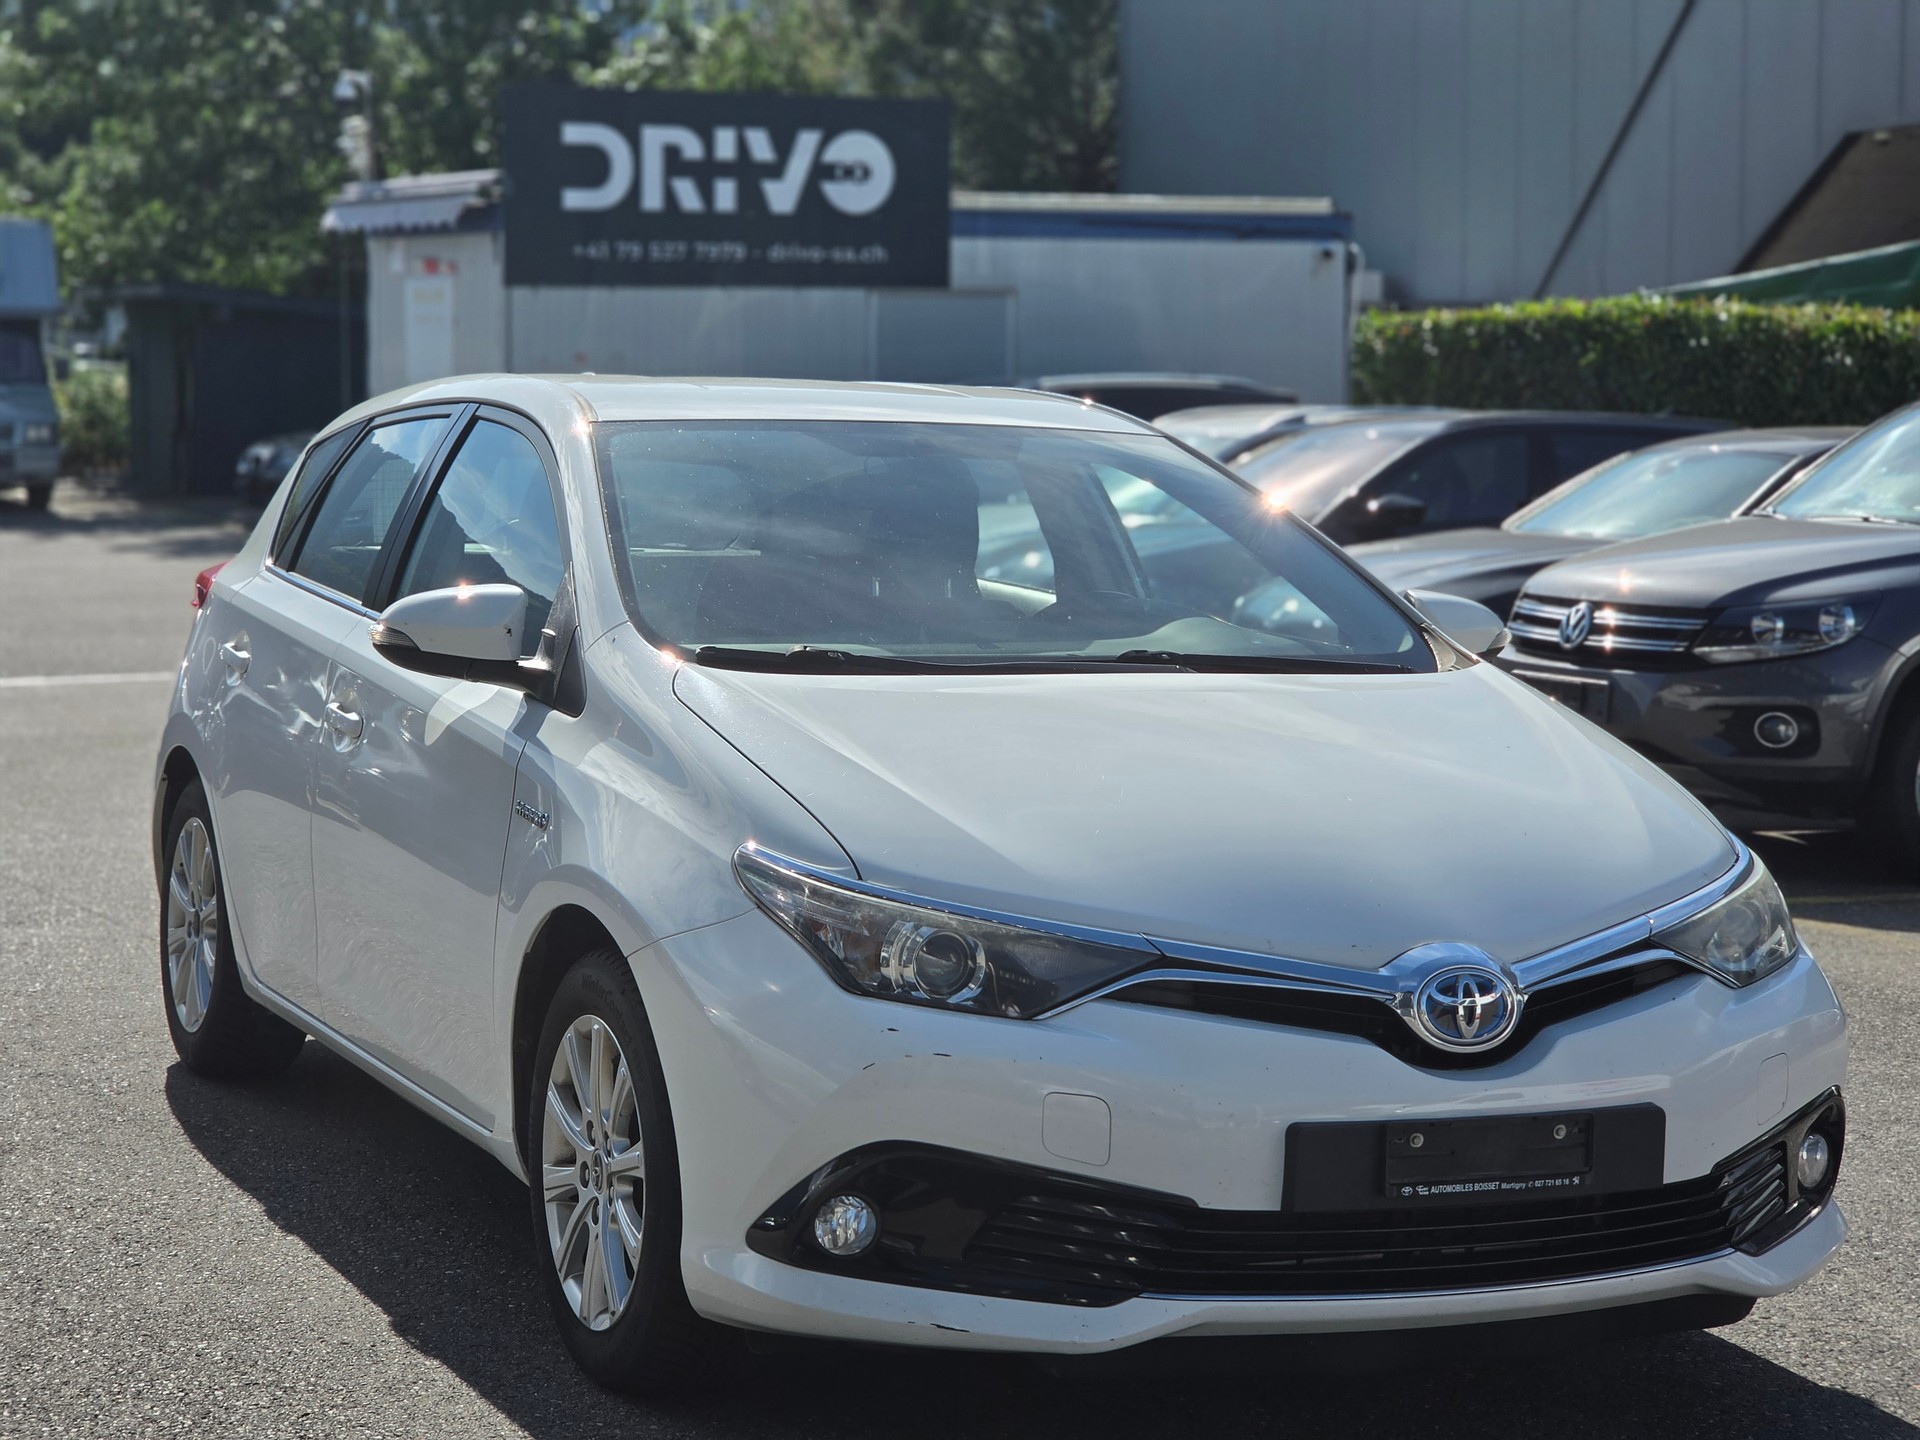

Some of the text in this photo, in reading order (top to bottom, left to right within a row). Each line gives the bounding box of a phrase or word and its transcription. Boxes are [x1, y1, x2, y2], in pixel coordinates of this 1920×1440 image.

[560, 121, 896, 216] DRIVO
[574, 242, 609, 261] +41
[614, 241, 643, 262] 79
[693, 241, 748, 262] 7979
[766, 242, 889, 264] drivo-sa.ch
[1430, 1183, 1473, 1194] AUTOMOBILES
[1474, 1182, 1500, 1191] BOISSET
[1501, 1182, 1527, 1190] Martigny
